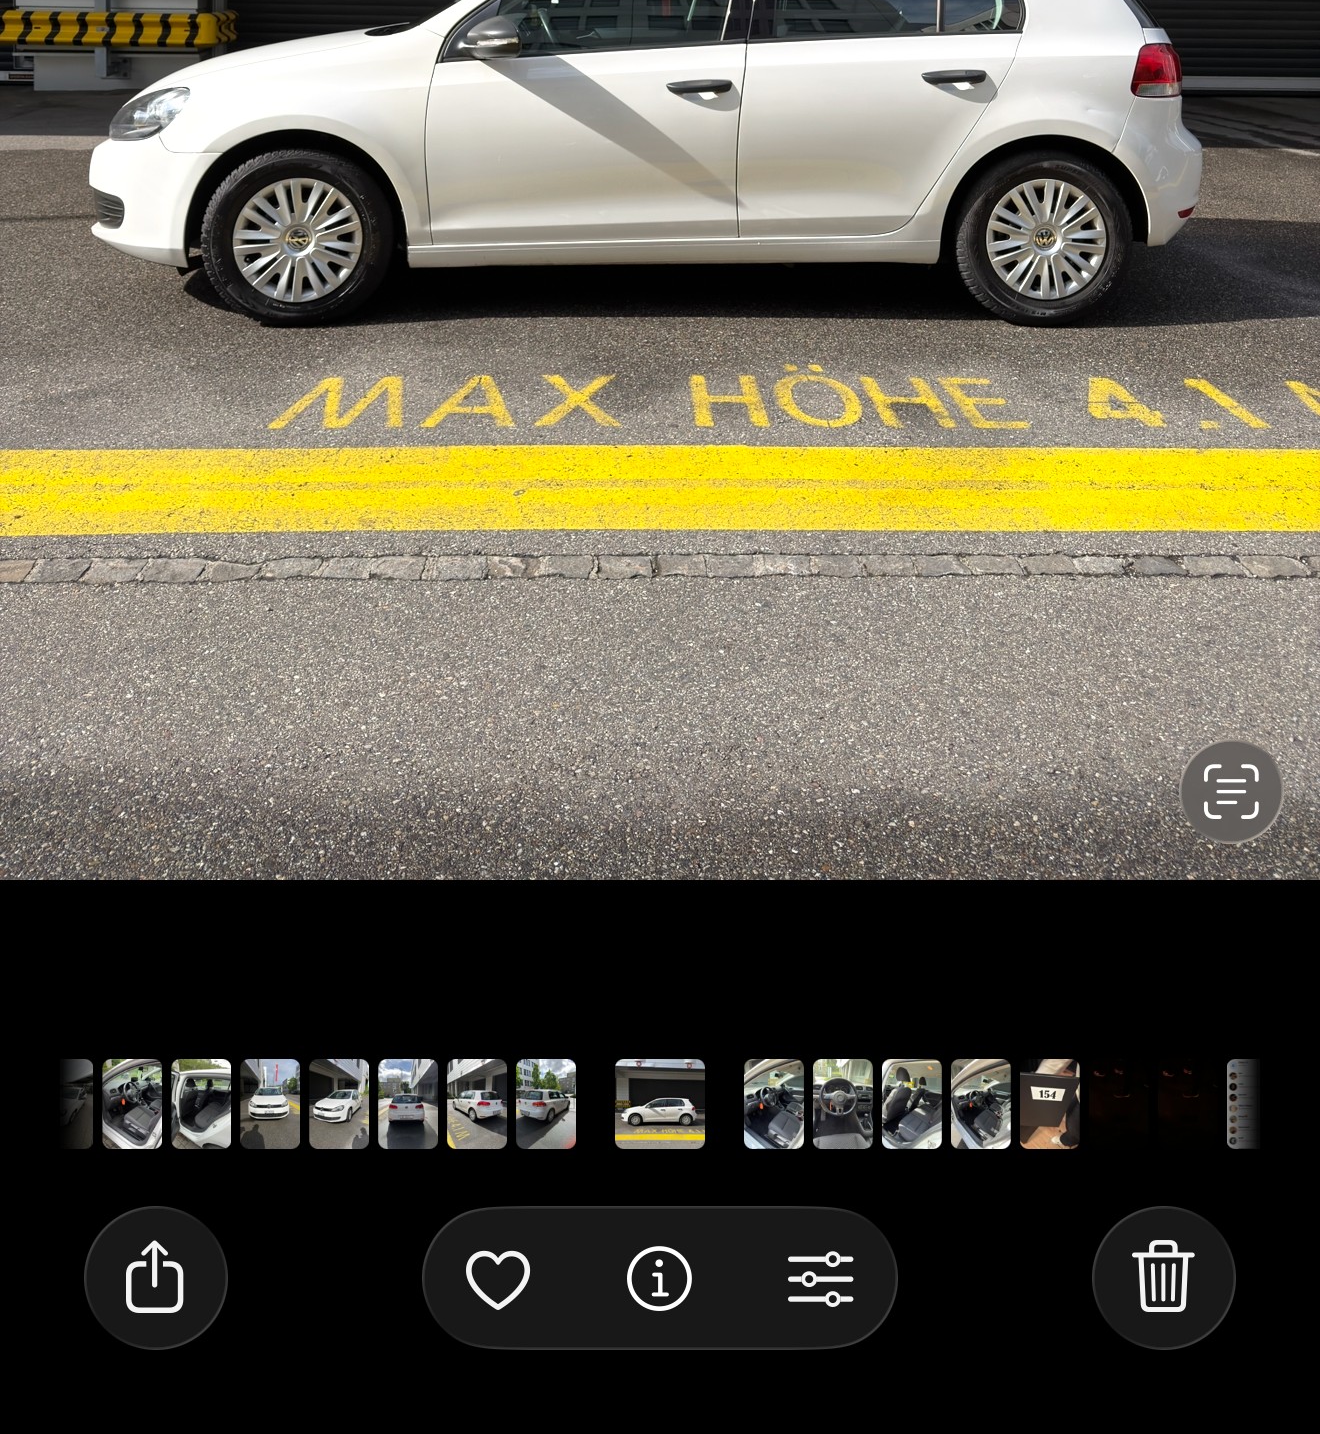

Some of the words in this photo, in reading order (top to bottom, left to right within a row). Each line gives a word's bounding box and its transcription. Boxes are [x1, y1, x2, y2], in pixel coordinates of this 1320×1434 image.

[266, 375, 622, 429] MAX
[688, 363, 1032, 430] HÖHE
[1039, 1090, 1057, 1100] 154
